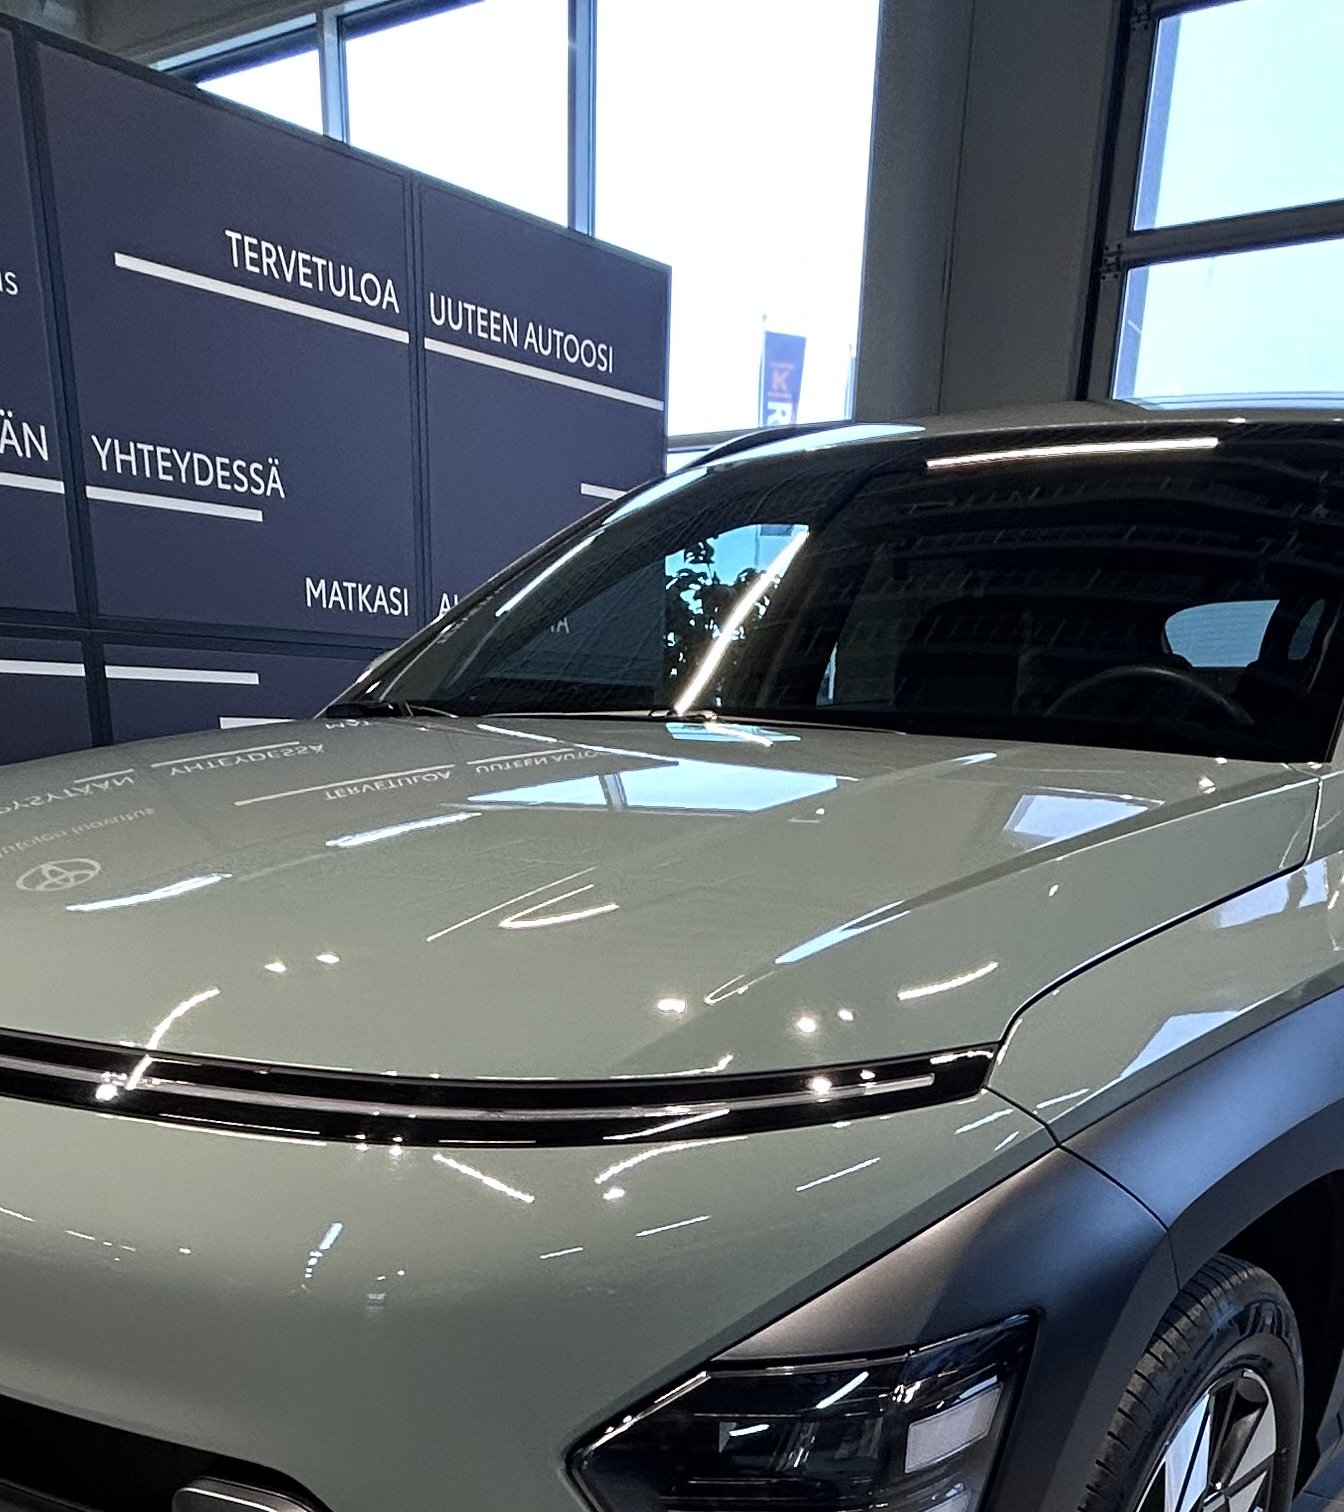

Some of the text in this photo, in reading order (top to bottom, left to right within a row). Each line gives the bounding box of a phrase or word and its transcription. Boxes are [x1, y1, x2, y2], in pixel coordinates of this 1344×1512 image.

[224, 229, 614, 374] TERVETULOA UUTEEN AUTOOSI
[90, 434, 286, 499] YHTEYDESSÄ
[305, 576, 410, 617] MATKASI
